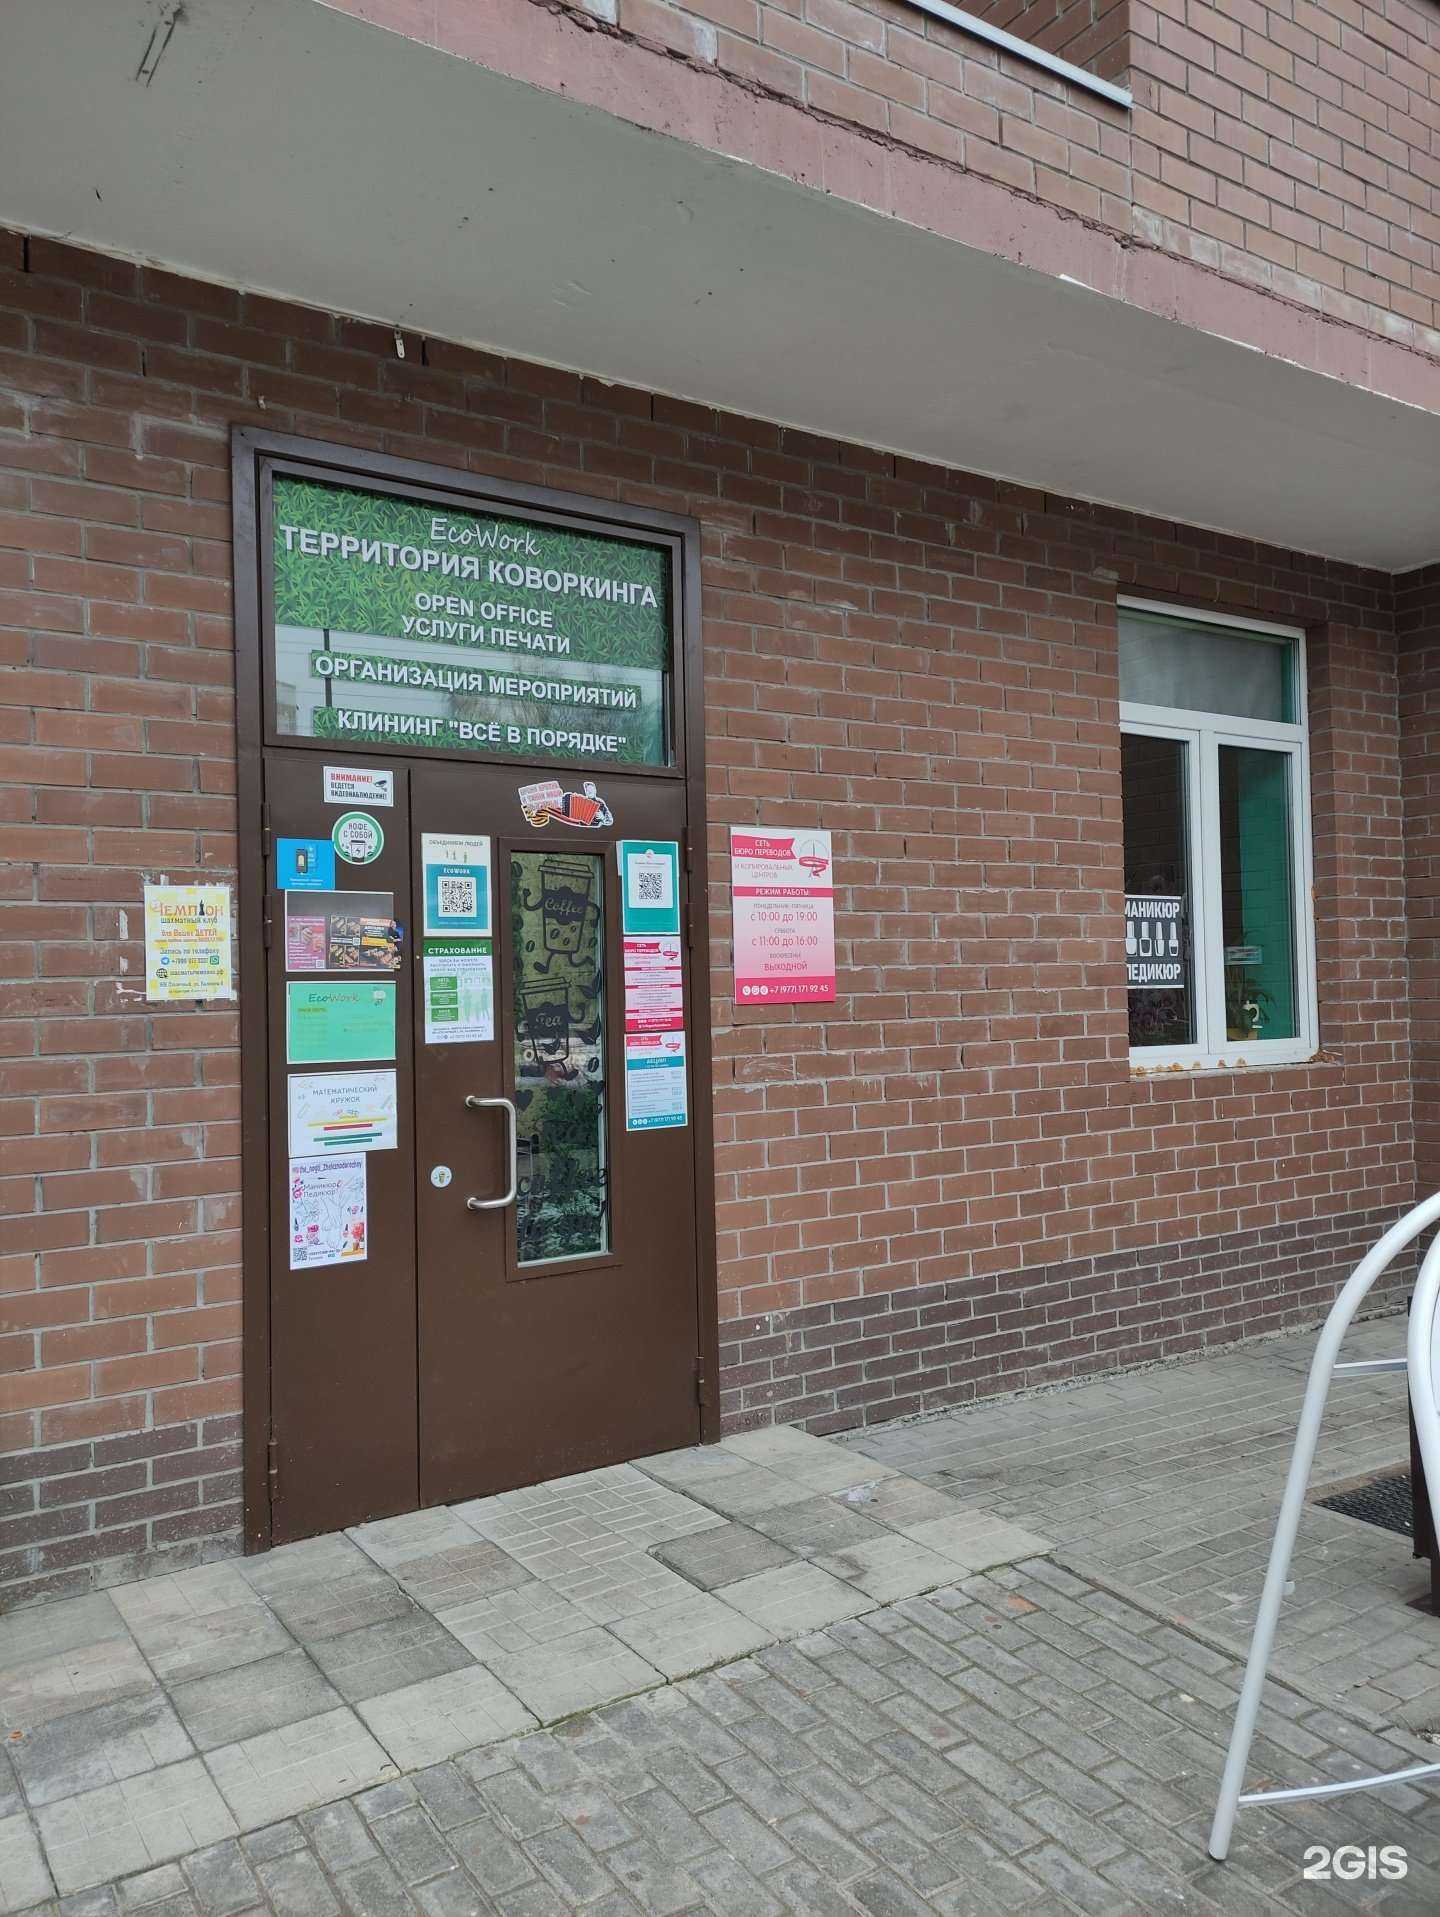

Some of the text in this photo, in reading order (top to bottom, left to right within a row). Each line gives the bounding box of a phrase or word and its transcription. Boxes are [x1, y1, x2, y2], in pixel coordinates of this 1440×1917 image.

[430, 517, 541, 556] EcoWork
[280, 524, 658, 608] ТЕРРИТОРИЯ КОВОРКИНГА
[415, 592, 553, 628] OPEN OFFICE
[401, 615, 570, 654] УСЛУГИ ПЕЧАТИ
[315, 656, 637, 708] ОРГАНИЗАЦИЯ МЕРОПРИЯТИЙ
[338, 711, 443, 738] КЛИНИНГ
[507, 728, 521, 744] В
[527, 729, 627, 753] ПОРЯДКЕ"
[348, 822, 368, 831] КОФЕ
[343, 830, 373, 839] С СОБОЙ
[755, 848, 791, 857] ПЕРЕВОДОВ
[755, 888, 781, 896] РЕЖИМ
[545, 899, 582, 918] Coffee
[758, 912, 780, 921] 10:00
[782, 914, 794, 923] до
[796, 912, 818, 921] 19:00
[759, 936, 780, 946] 11:00
[782, 938, 794, 948] до
[796, 936, 818, 946] 16:00
[764, 961, 808, 972] ВЫХОДНОЙ
[308, 993, 360, 1004] EcoWork
[536, 1013, 563, 1027] Tea
[312, 1086, 378, 1096] МАТЕМАТИЧЕСКИЙ
[330, 1096, 360, 1104] КРУЖОК
